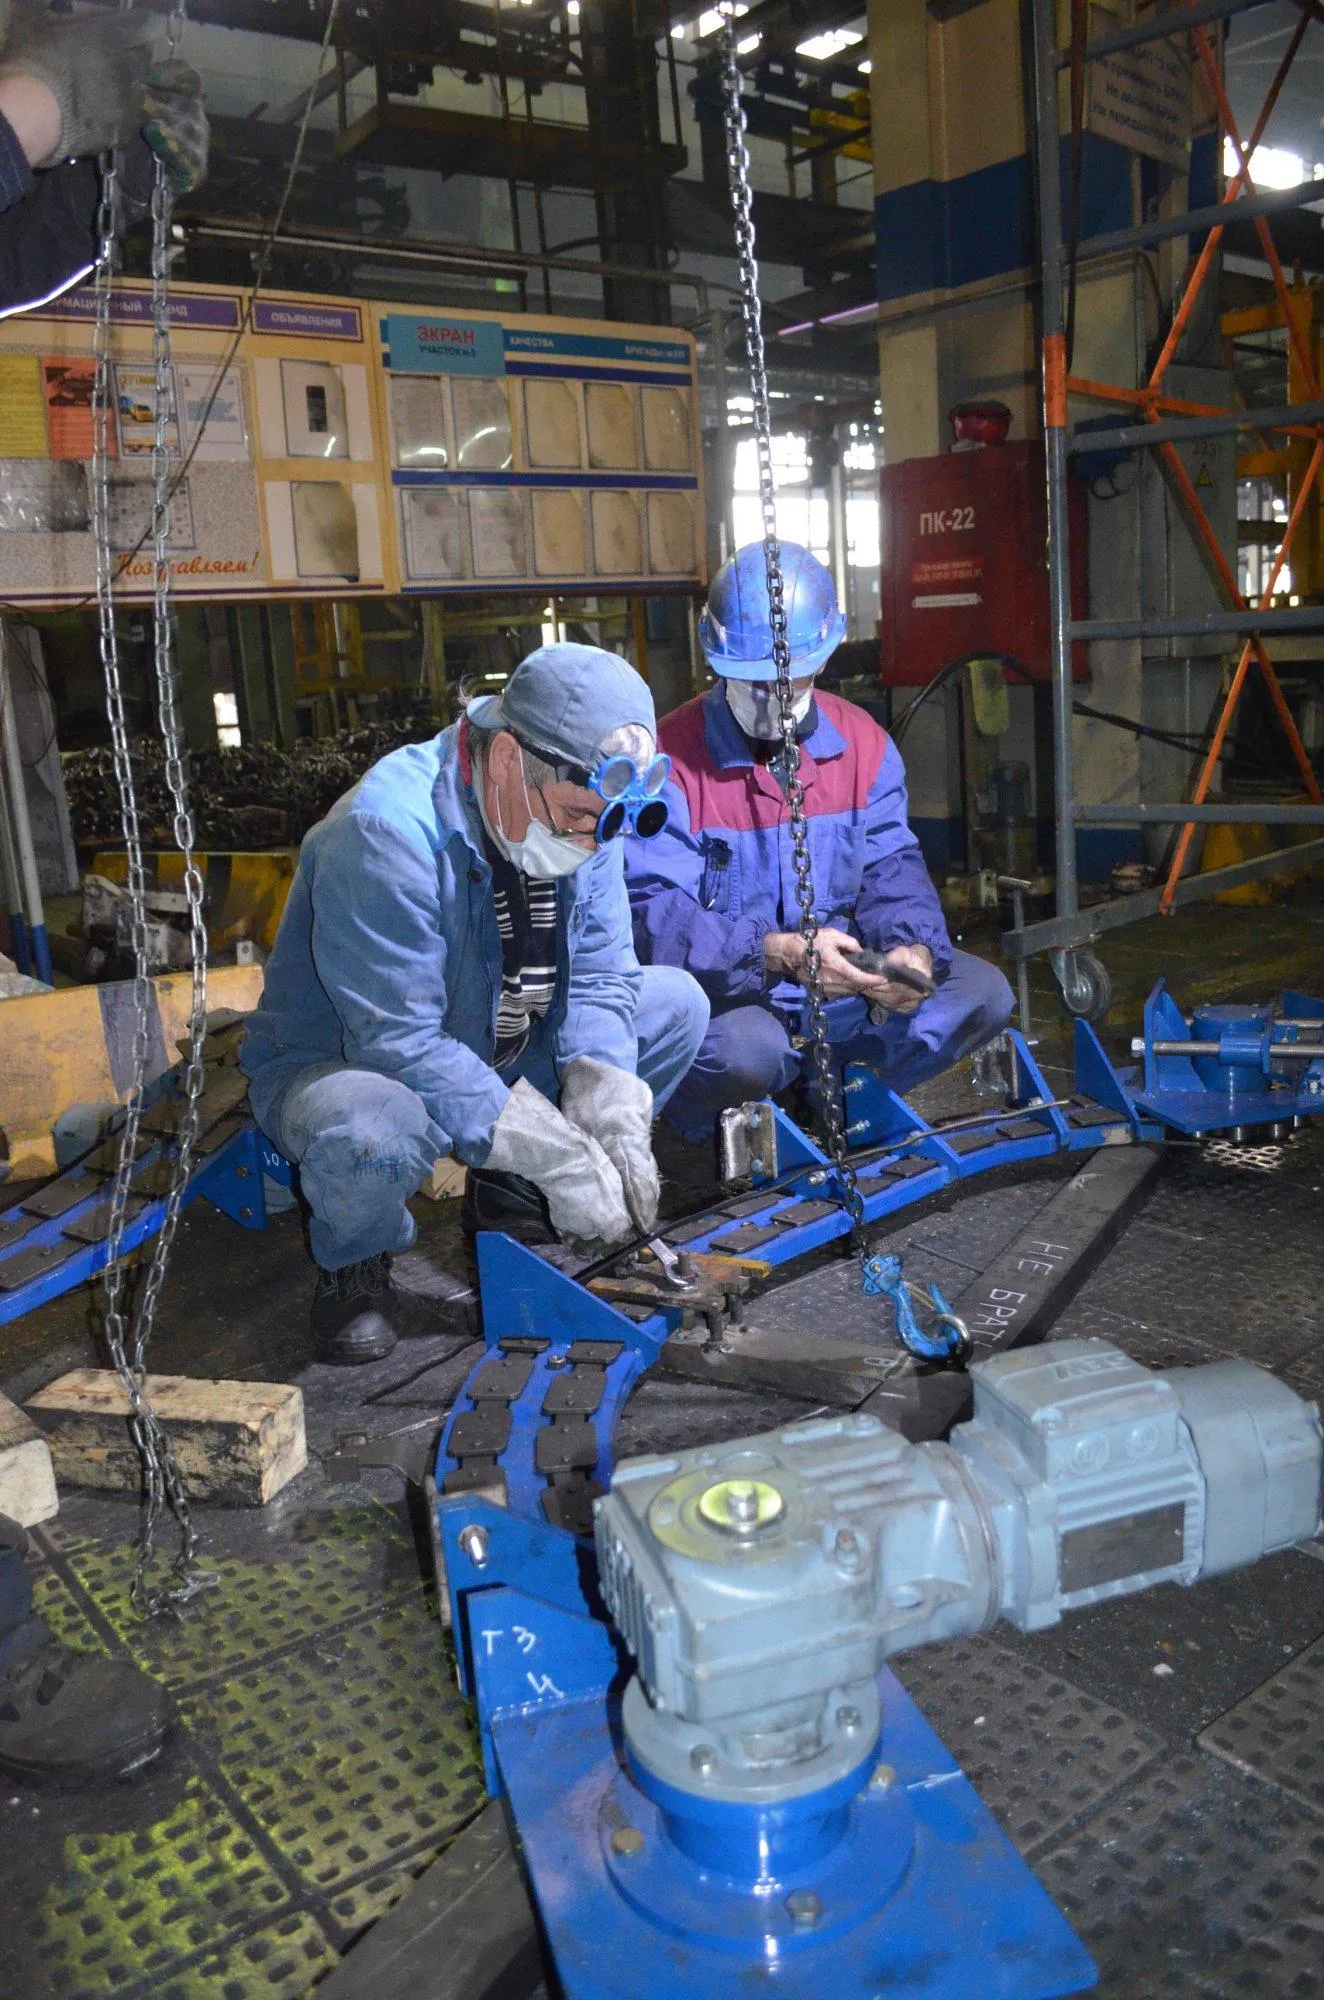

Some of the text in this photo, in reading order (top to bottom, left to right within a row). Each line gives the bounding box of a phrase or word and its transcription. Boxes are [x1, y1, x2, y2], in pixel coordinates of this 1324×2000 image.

[270, 311, 342, 329] ОБЪЯВЛЕНИЯ
[416, 324, 475, 344] ЭКРАН
[509, 335, 554, 348] КАЧЕСТВА
[419, 344, 461, 356] УЧАСТОК
[920, 506, 975, 536] ПК-22
[1018, 1240, 1070, 1276] НЕ
